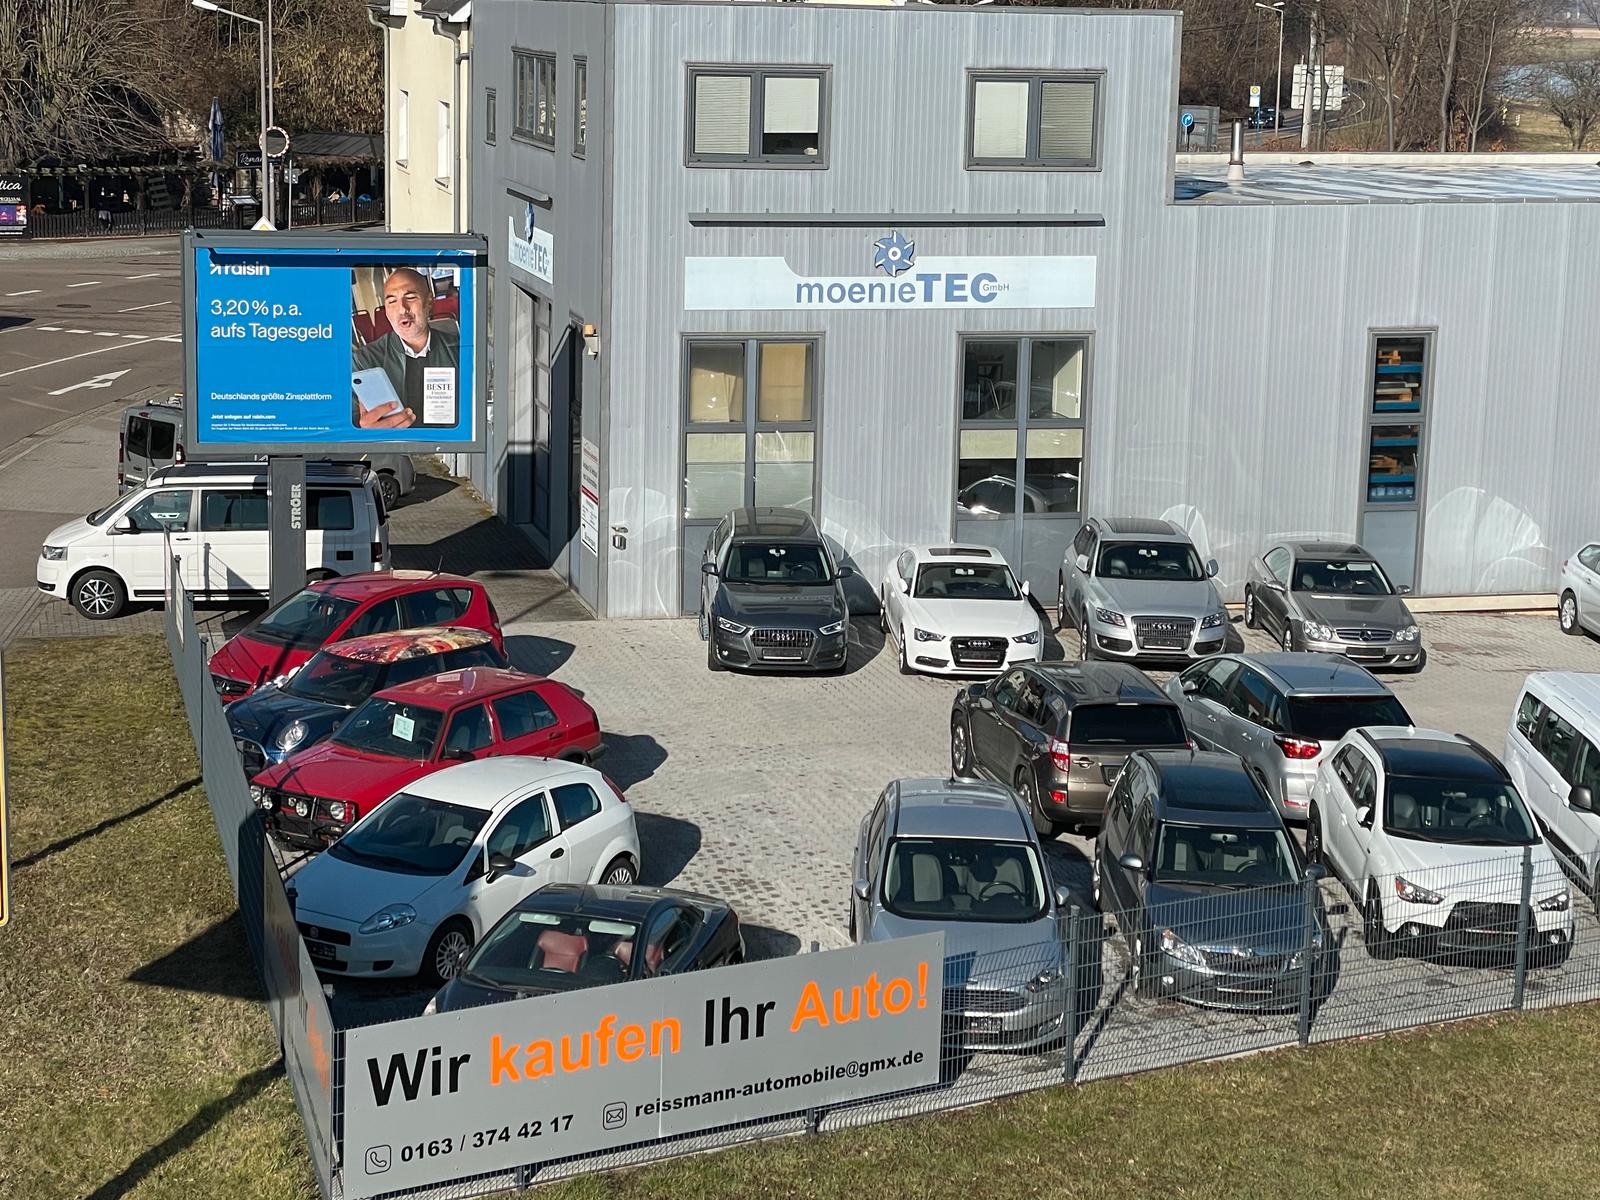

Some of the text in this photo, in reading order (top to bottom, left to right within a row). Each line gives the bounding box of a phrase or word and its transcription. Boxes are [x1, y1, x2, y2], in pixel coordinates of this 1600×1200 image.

[224, 261, 270, 276] raisin
[982, 282, 1010, 292] GmbH
[210, 322, 333, 342] aufs Tagesgeld
[426, 383, 453, 391] BESTE
[211, 392, 332, 402] Deutschlands größte Zinsplattform
[367, 1045, 471, 1107] Wir
[489, 1013, 682, 1086] kaufen
[704, 996, 776, 1047] Ihr
[789, 961, 928, 1032] Auto!
[635, 1050, 924, 1117] reissmann-automobile@gmx.de
[400, 1114, 574, 1162] 0163 / 374 42 17
